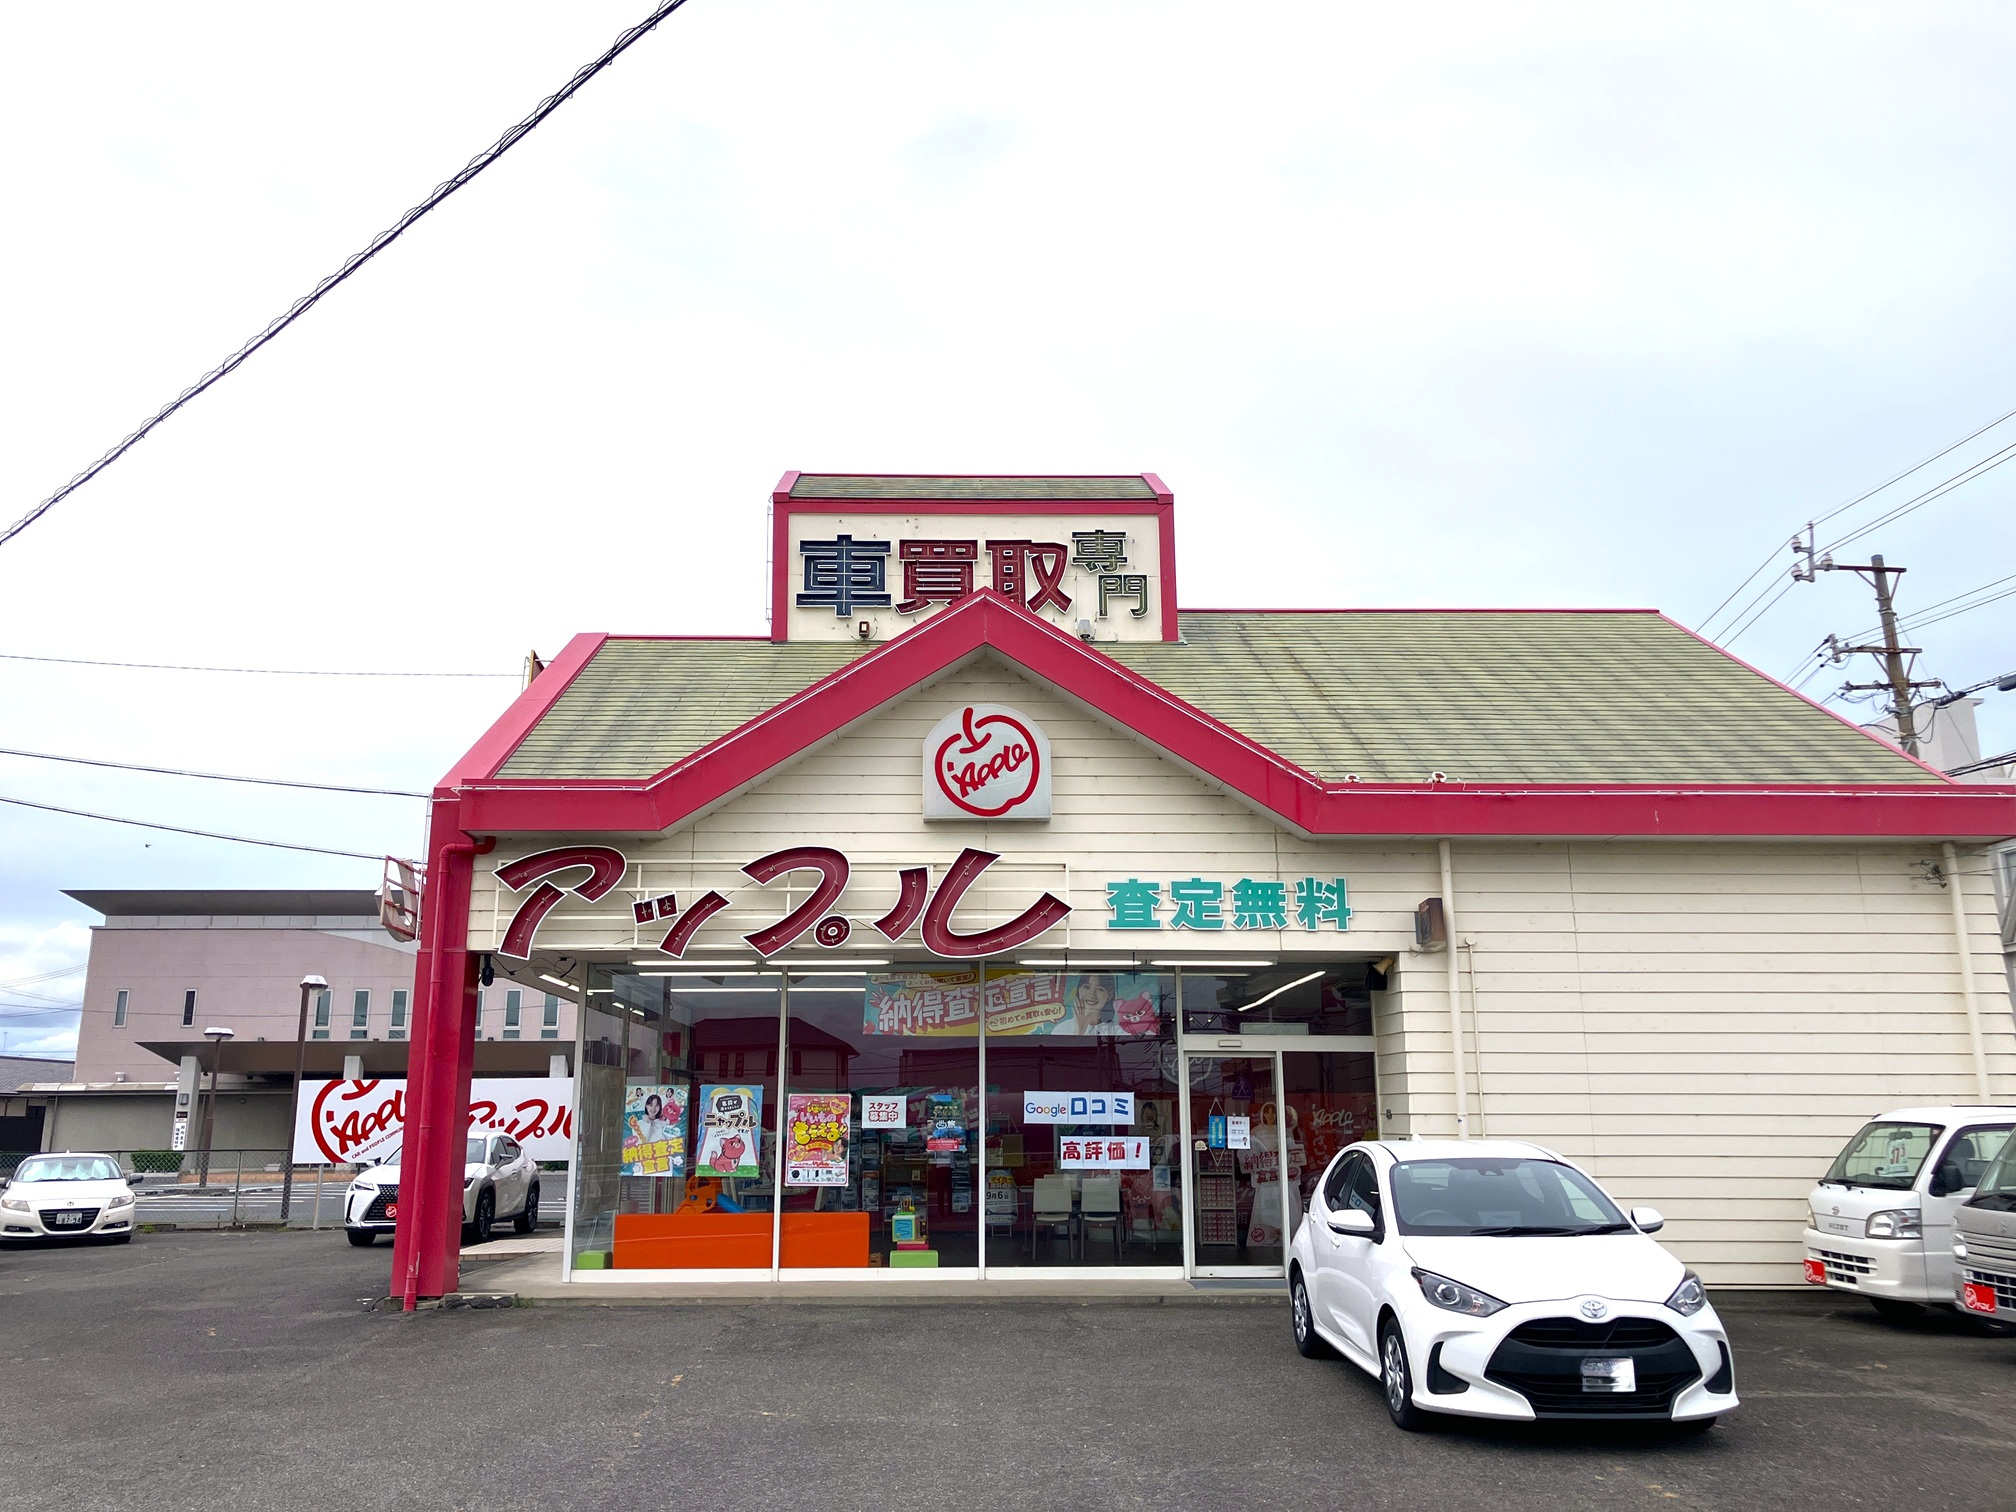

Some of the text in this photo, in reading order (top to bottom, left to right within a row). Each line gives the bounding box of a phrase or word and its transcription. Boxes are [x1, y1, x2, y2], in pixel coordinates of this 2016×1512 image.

[491, 845, 1073, 960] アップル
[1106, 877, 1353, 931] 査定無料
[869, 1102, 898, 1110] スタッフ
[1025, 1097, 1129, 1117] Google 口コミ
[705, 1112, 757, 1127] ニャップル
[800, 1111, 836, 1123] いいもの
[869, 1110, 898, 1122] 募集中
[351, 1151, 361, 1159] CAR
[369, 1137, 385, 1149] PEOPLE
[622, 1137, 684, 1163] 納得査定
[1828, 1222, 1849, 1231] HIJET
